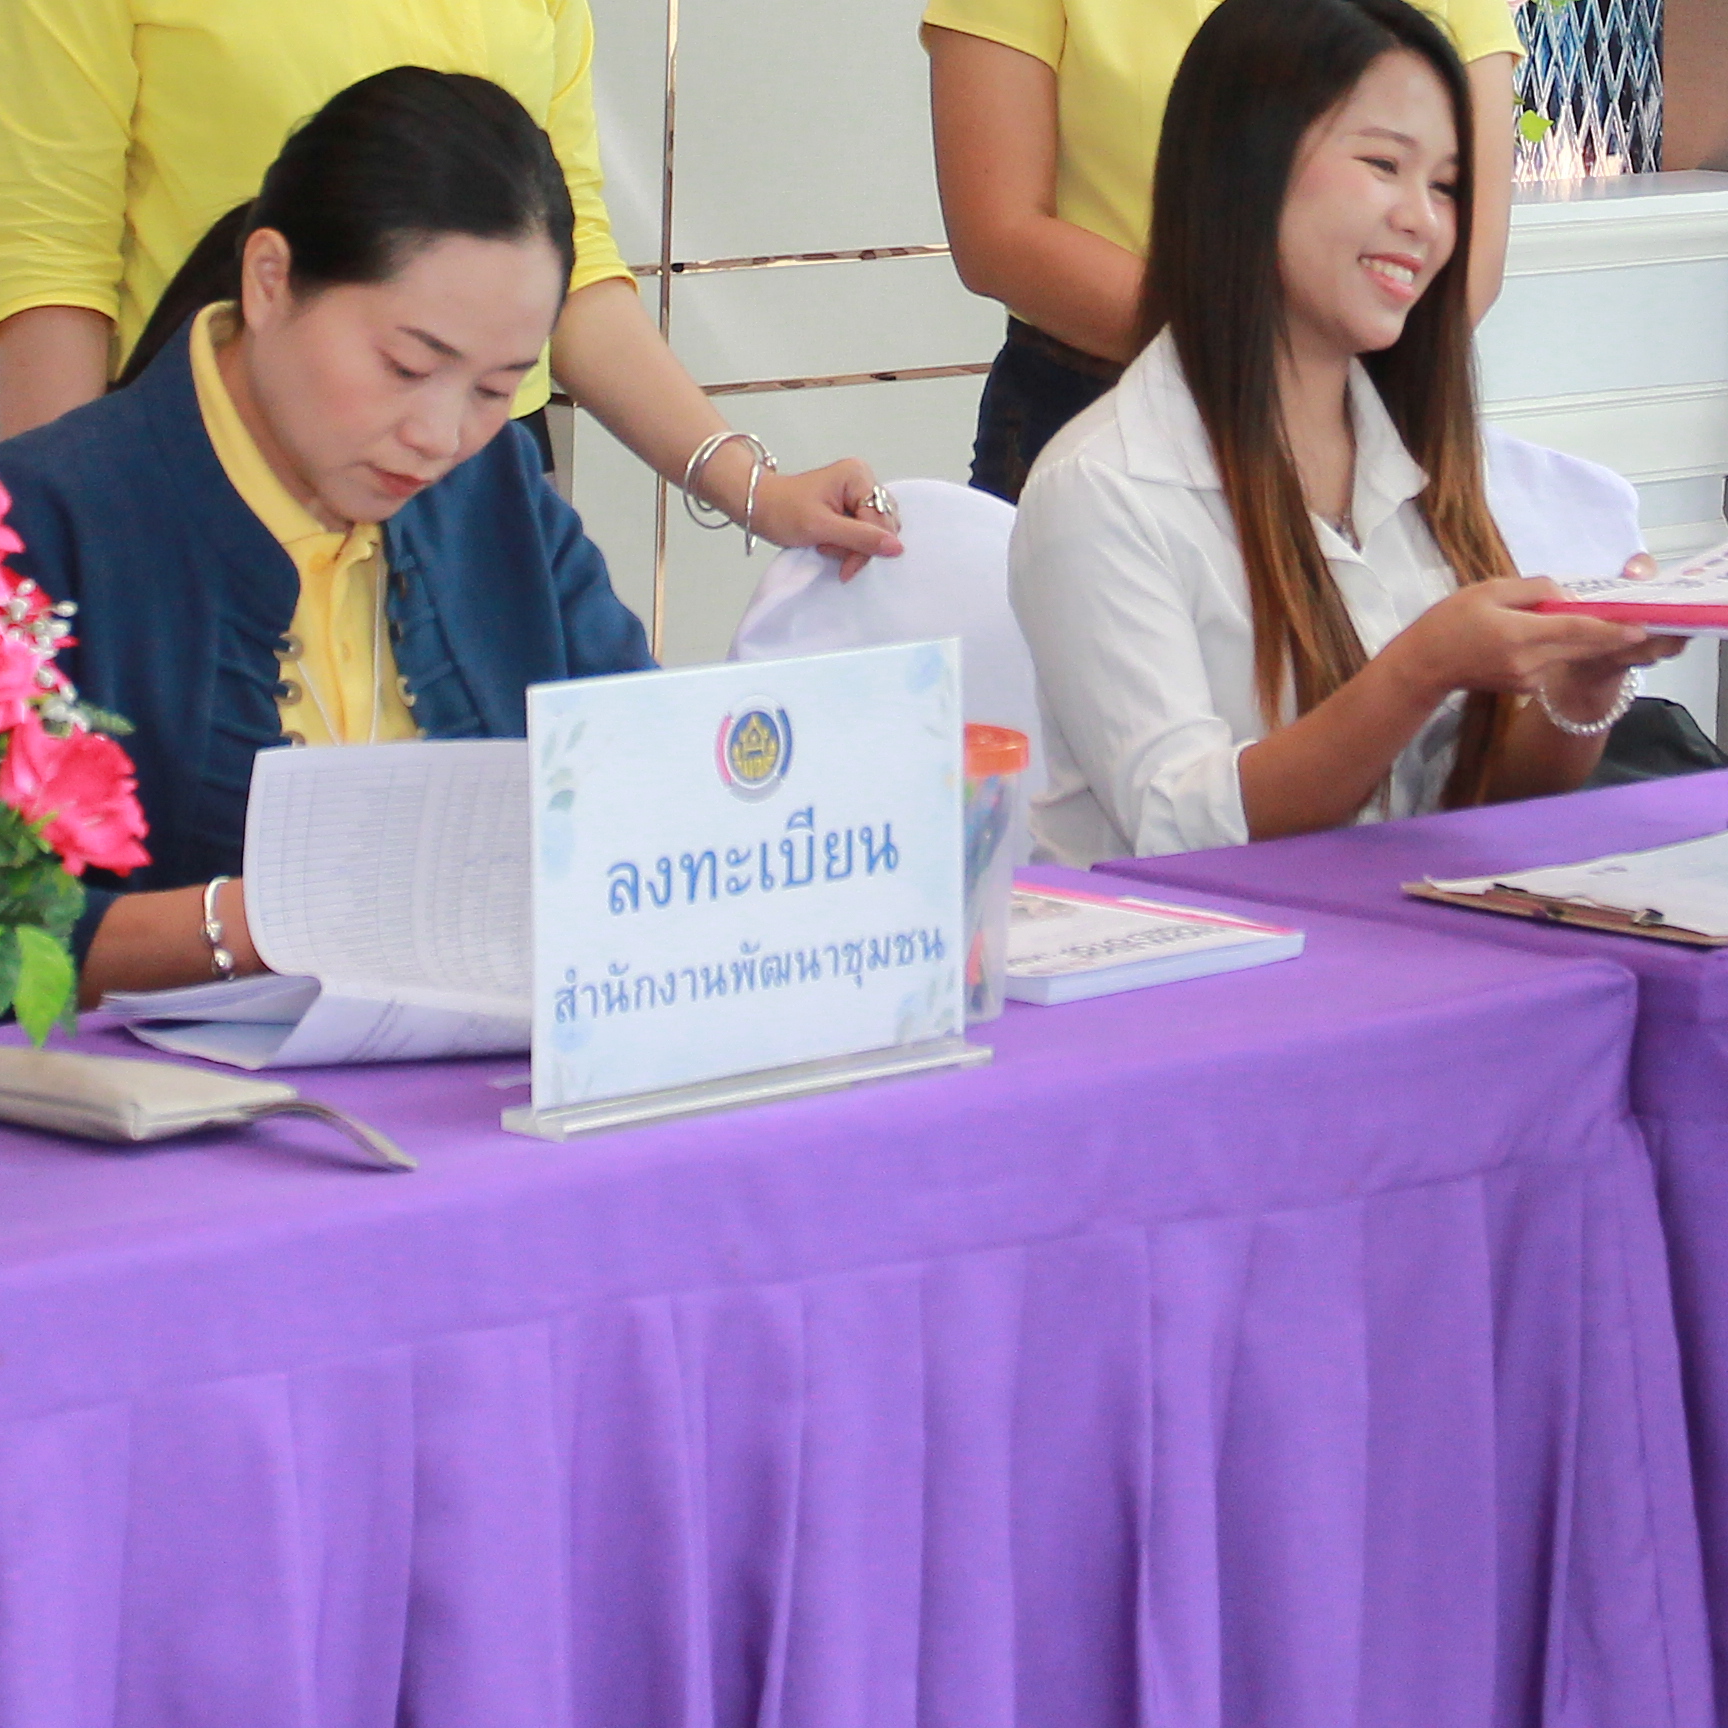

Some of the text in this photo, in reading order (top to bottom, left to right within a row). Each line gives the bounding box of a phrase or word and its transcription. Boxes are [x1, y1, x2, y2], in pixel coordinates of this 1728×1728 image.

[606, 806, 900, 915] ลงทะเบียน
[553, 926, 946, 1024] สำนักงานพัฒนาชุมชน
